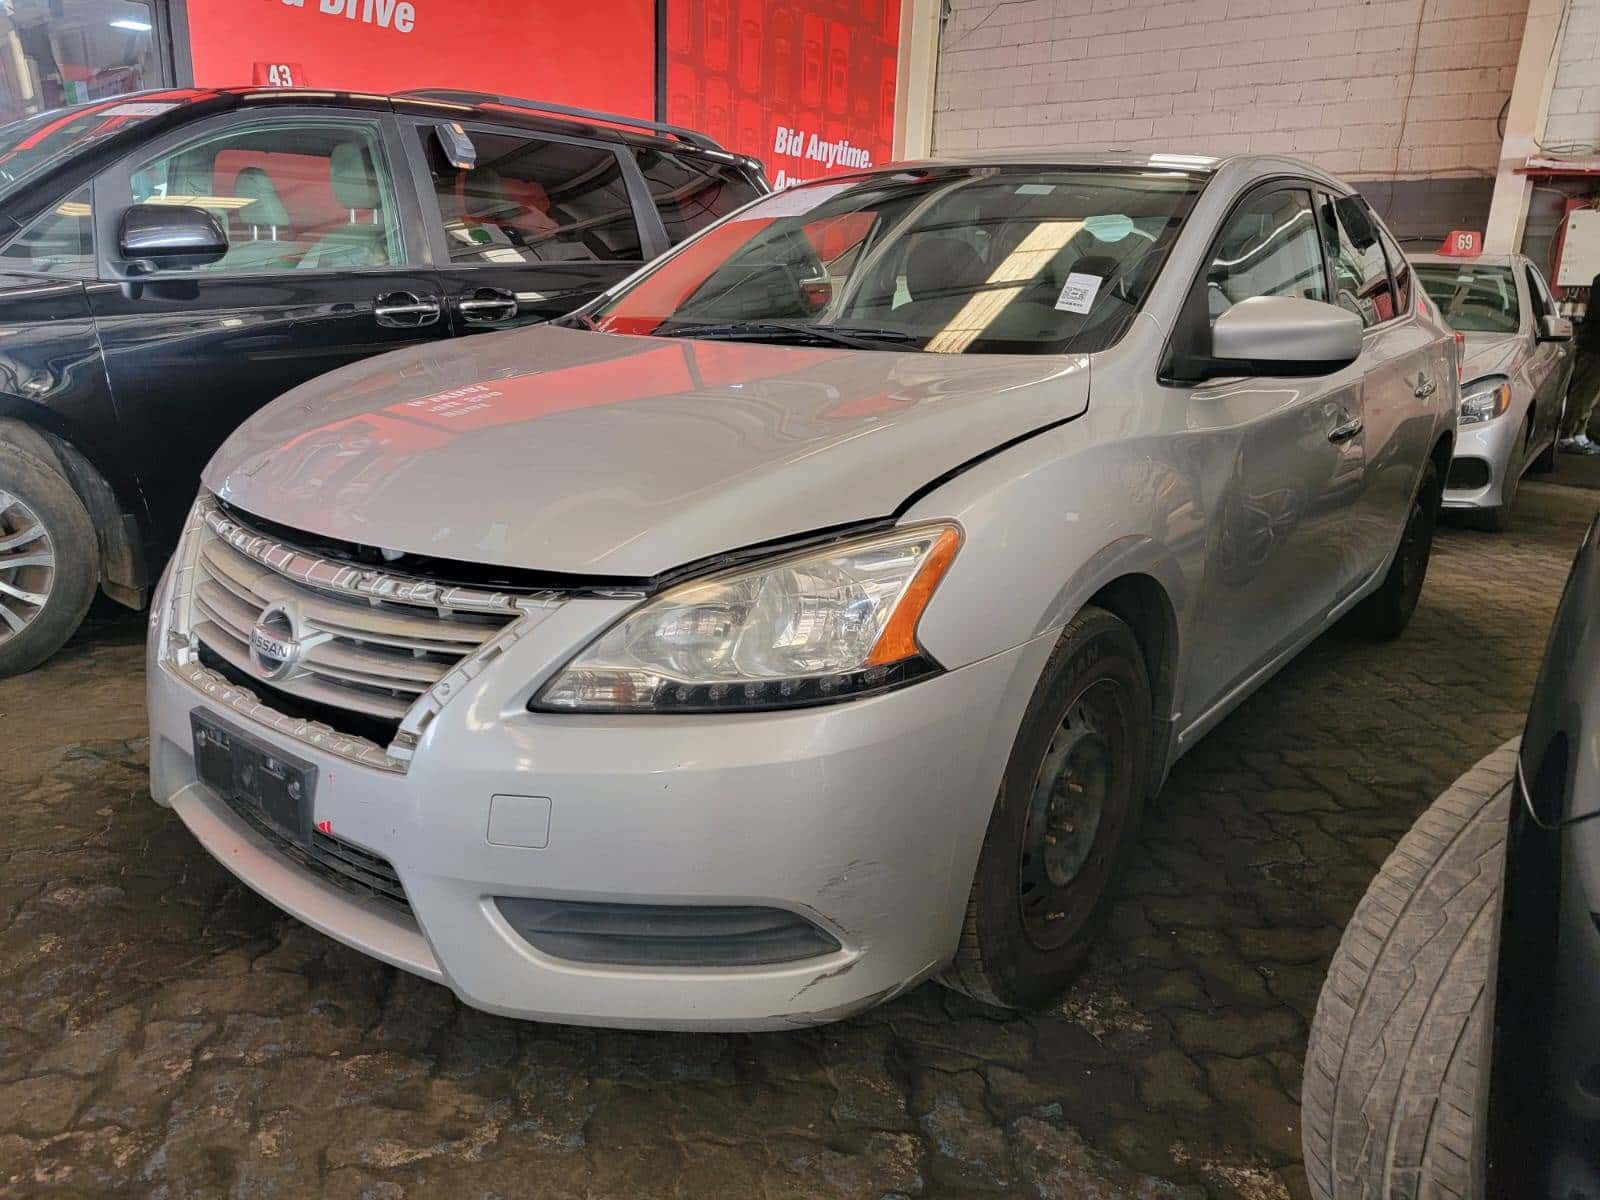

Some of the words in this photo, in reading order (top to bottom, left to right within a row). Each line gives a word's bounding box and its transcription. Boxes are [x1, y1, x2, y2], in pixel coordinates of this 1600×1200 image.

[268, 64, 293, 87] 43
[774, 126, 805, 158] Bid
[805, 133, 872, 169] Anytime.
[1457, 233, 1473, 250] 69
[249, 628, 289, 658] NISSAN
